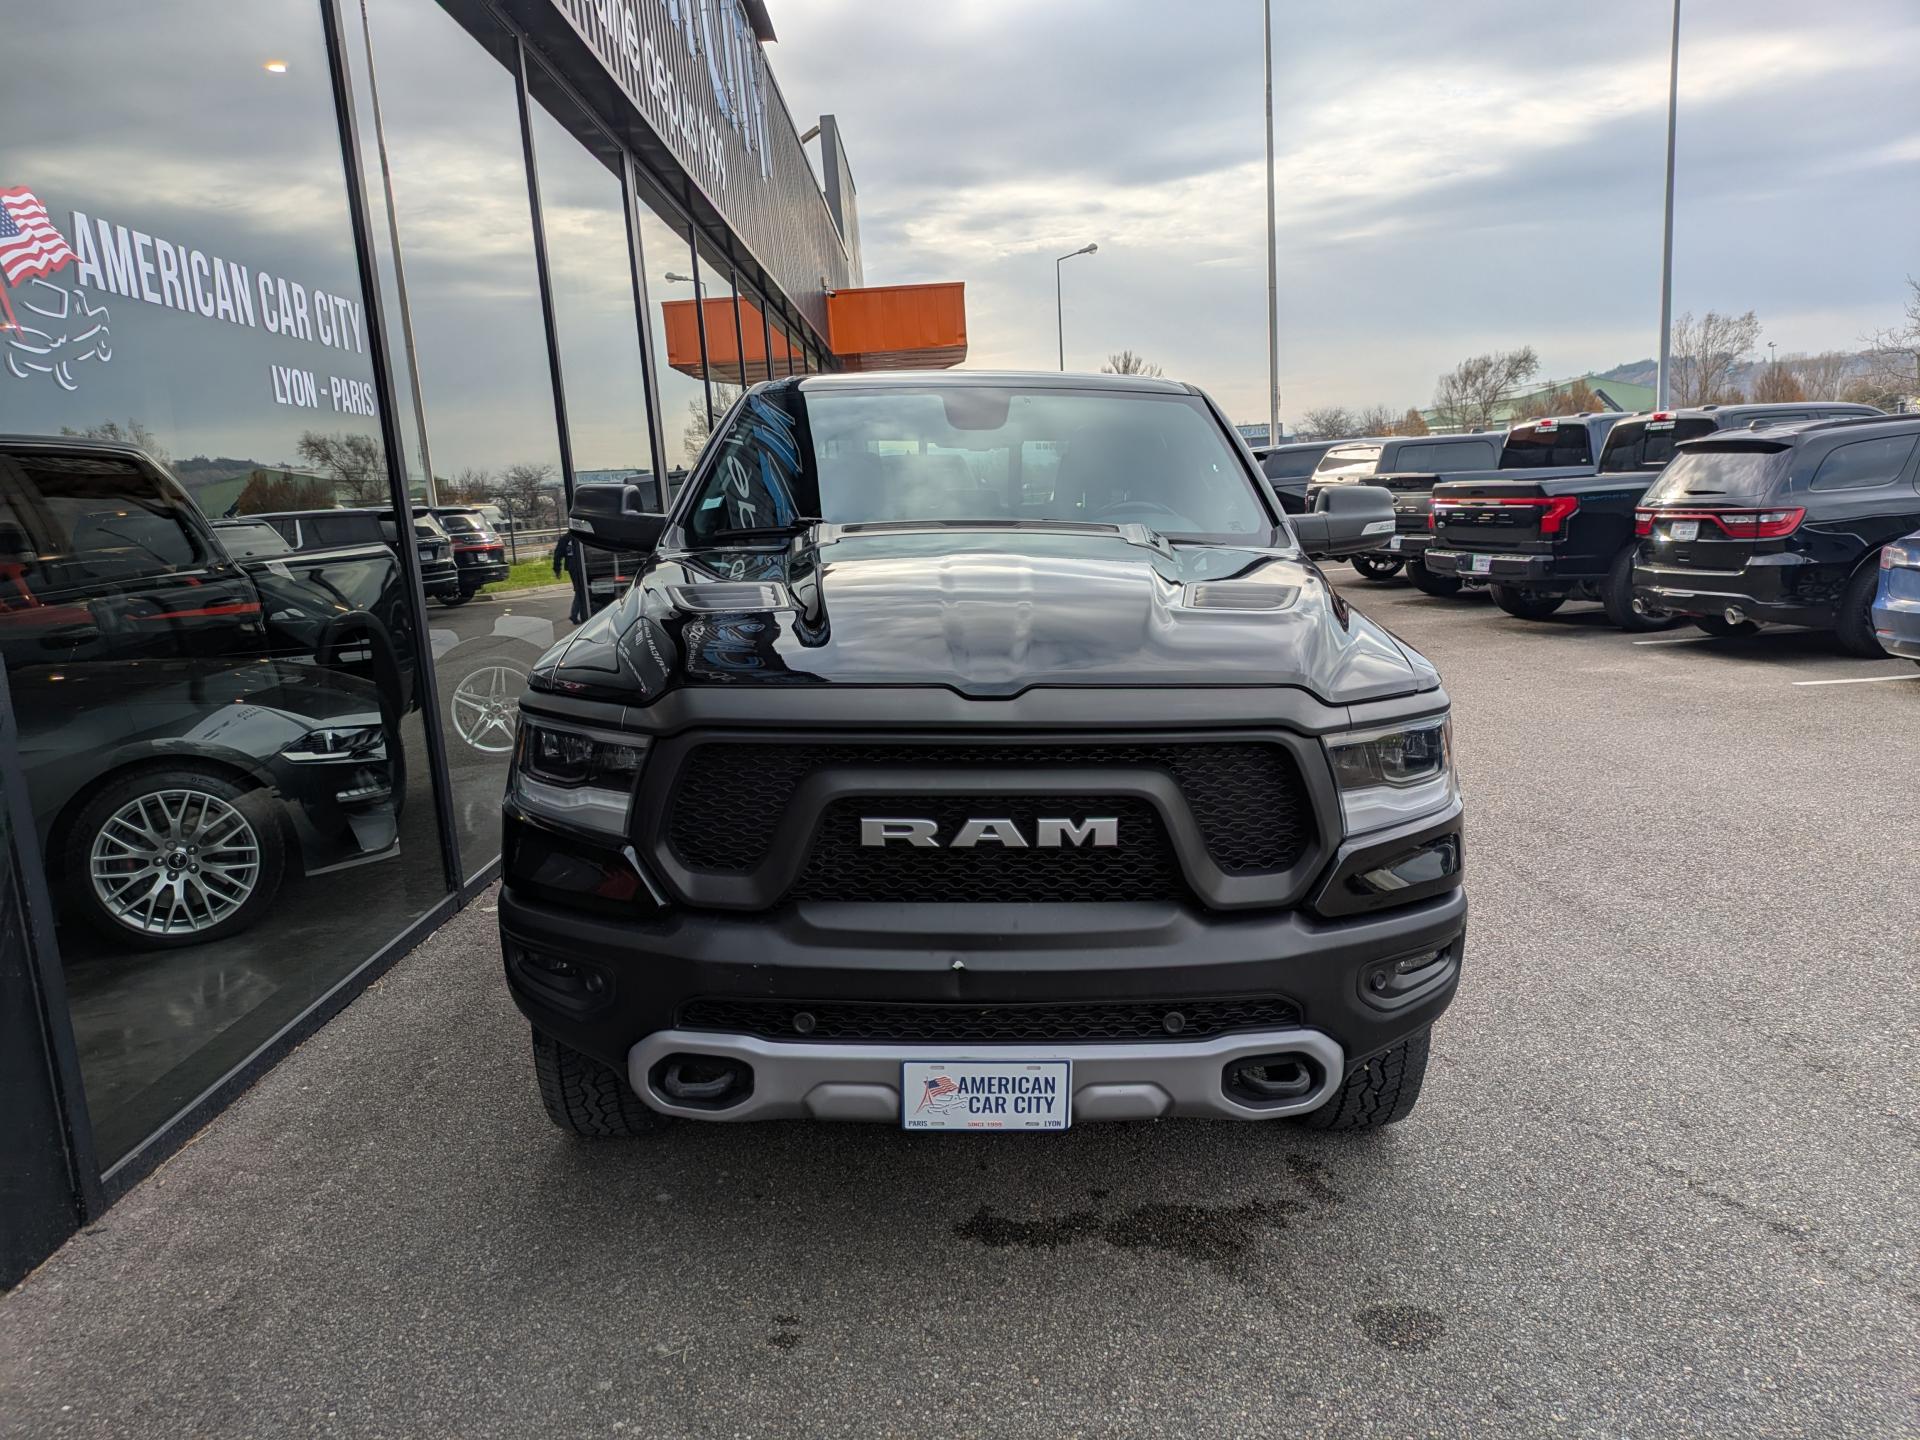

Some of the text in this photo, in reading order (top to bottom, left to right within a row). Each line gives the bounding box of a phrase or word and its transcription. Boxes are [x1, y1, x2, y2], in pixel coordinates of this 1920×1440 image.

[644, 29, 698, 153] depuis
[698, 107, 727, 190] 1999
[70, 211, 362, 353] AMERICAN CAR CITY
[271, 365, 318, 408] LYON
[330, 376, 375, 416] PARIS
[860, 817, 1119, 848] RAM
[958, 1076, 1056, 1095] AMERICAN
[968, 1096, 1056, 1114] CAR CITY
